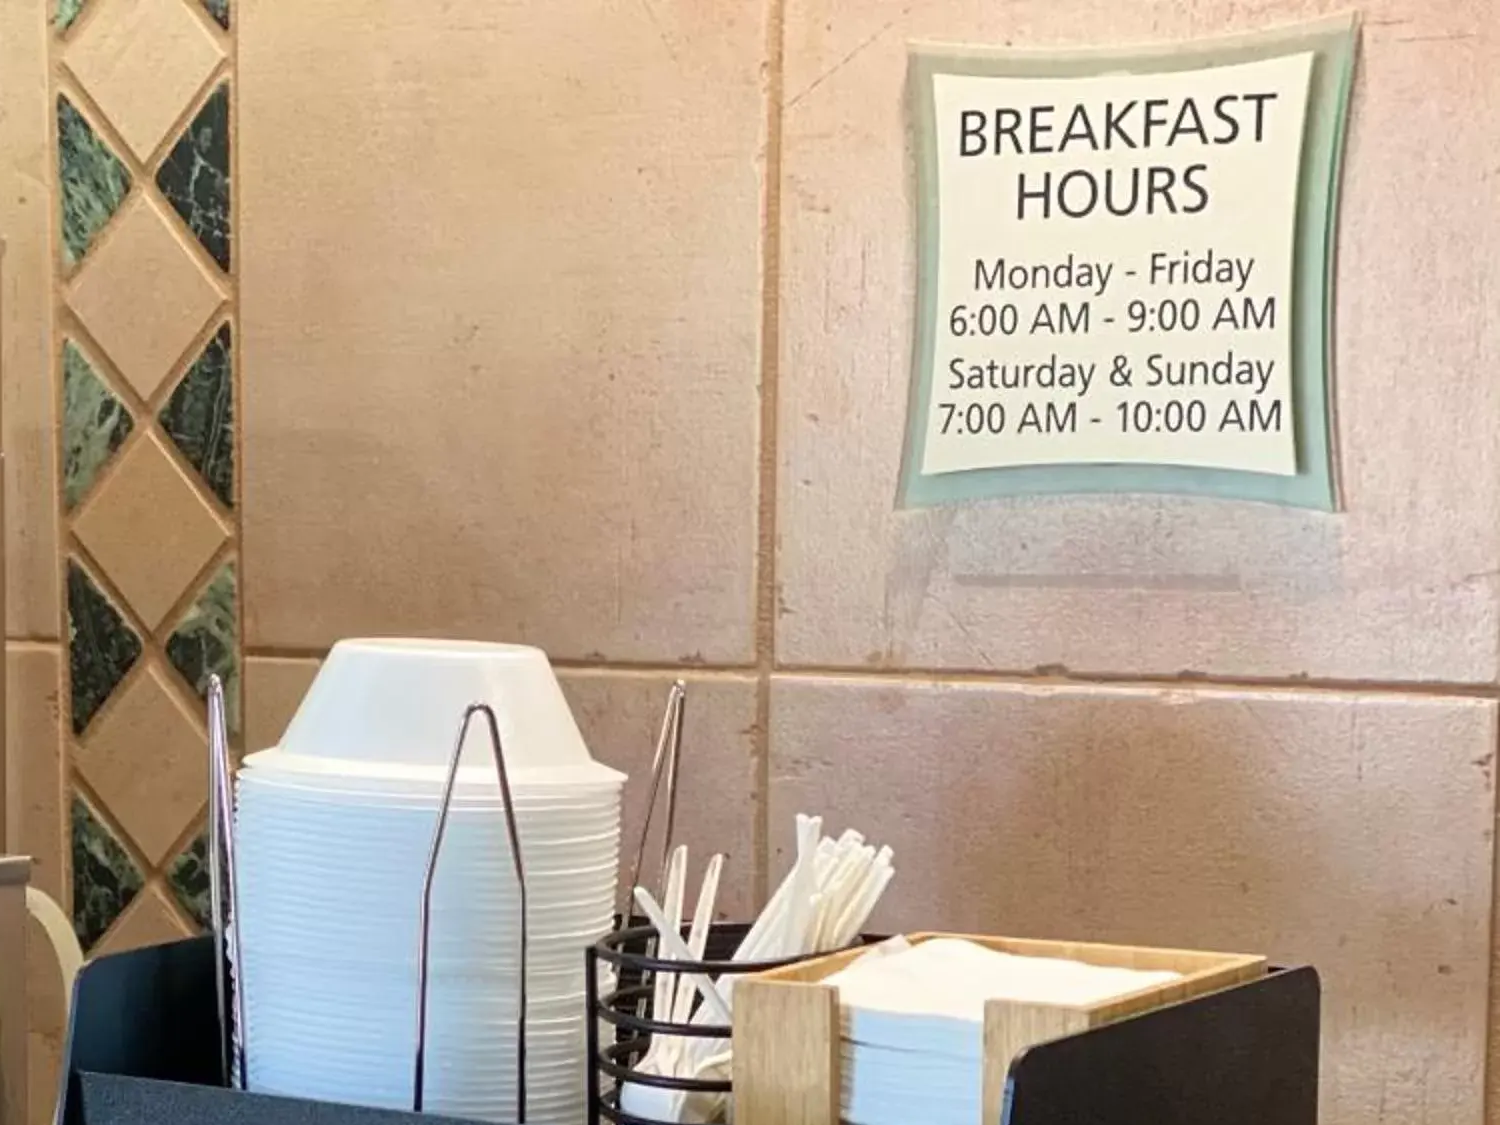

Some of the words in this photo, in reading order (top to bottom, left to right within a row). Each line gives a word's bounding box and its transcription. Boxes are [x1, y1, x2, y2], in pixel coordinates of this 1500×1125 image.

[959, 93, 1278, 157] BREAKFAST
[1016, 164, 1209, 220] HOURS
[974, 254, 1113, 296] Monday
[1149, 249, 1255, 292] Friday
[949, 304, 1018, 336] 6:00
[1030, 302, 1090, 334] AM
[1127, 298, 1200, 332] 9:00
[1213, 296, 1276, 330] AM
[948, 354, 1096, 396] Saturday
[1109, 355, 1132, 386] &
[1146, 351, 1275, 392] Sunday
[938, 403, 1005, 435] 7:00
[1016, 402, 1077, 434] AM
[1117, 400, 1206, 432] 10:00
[1218, 399, 1282, 432] AM
